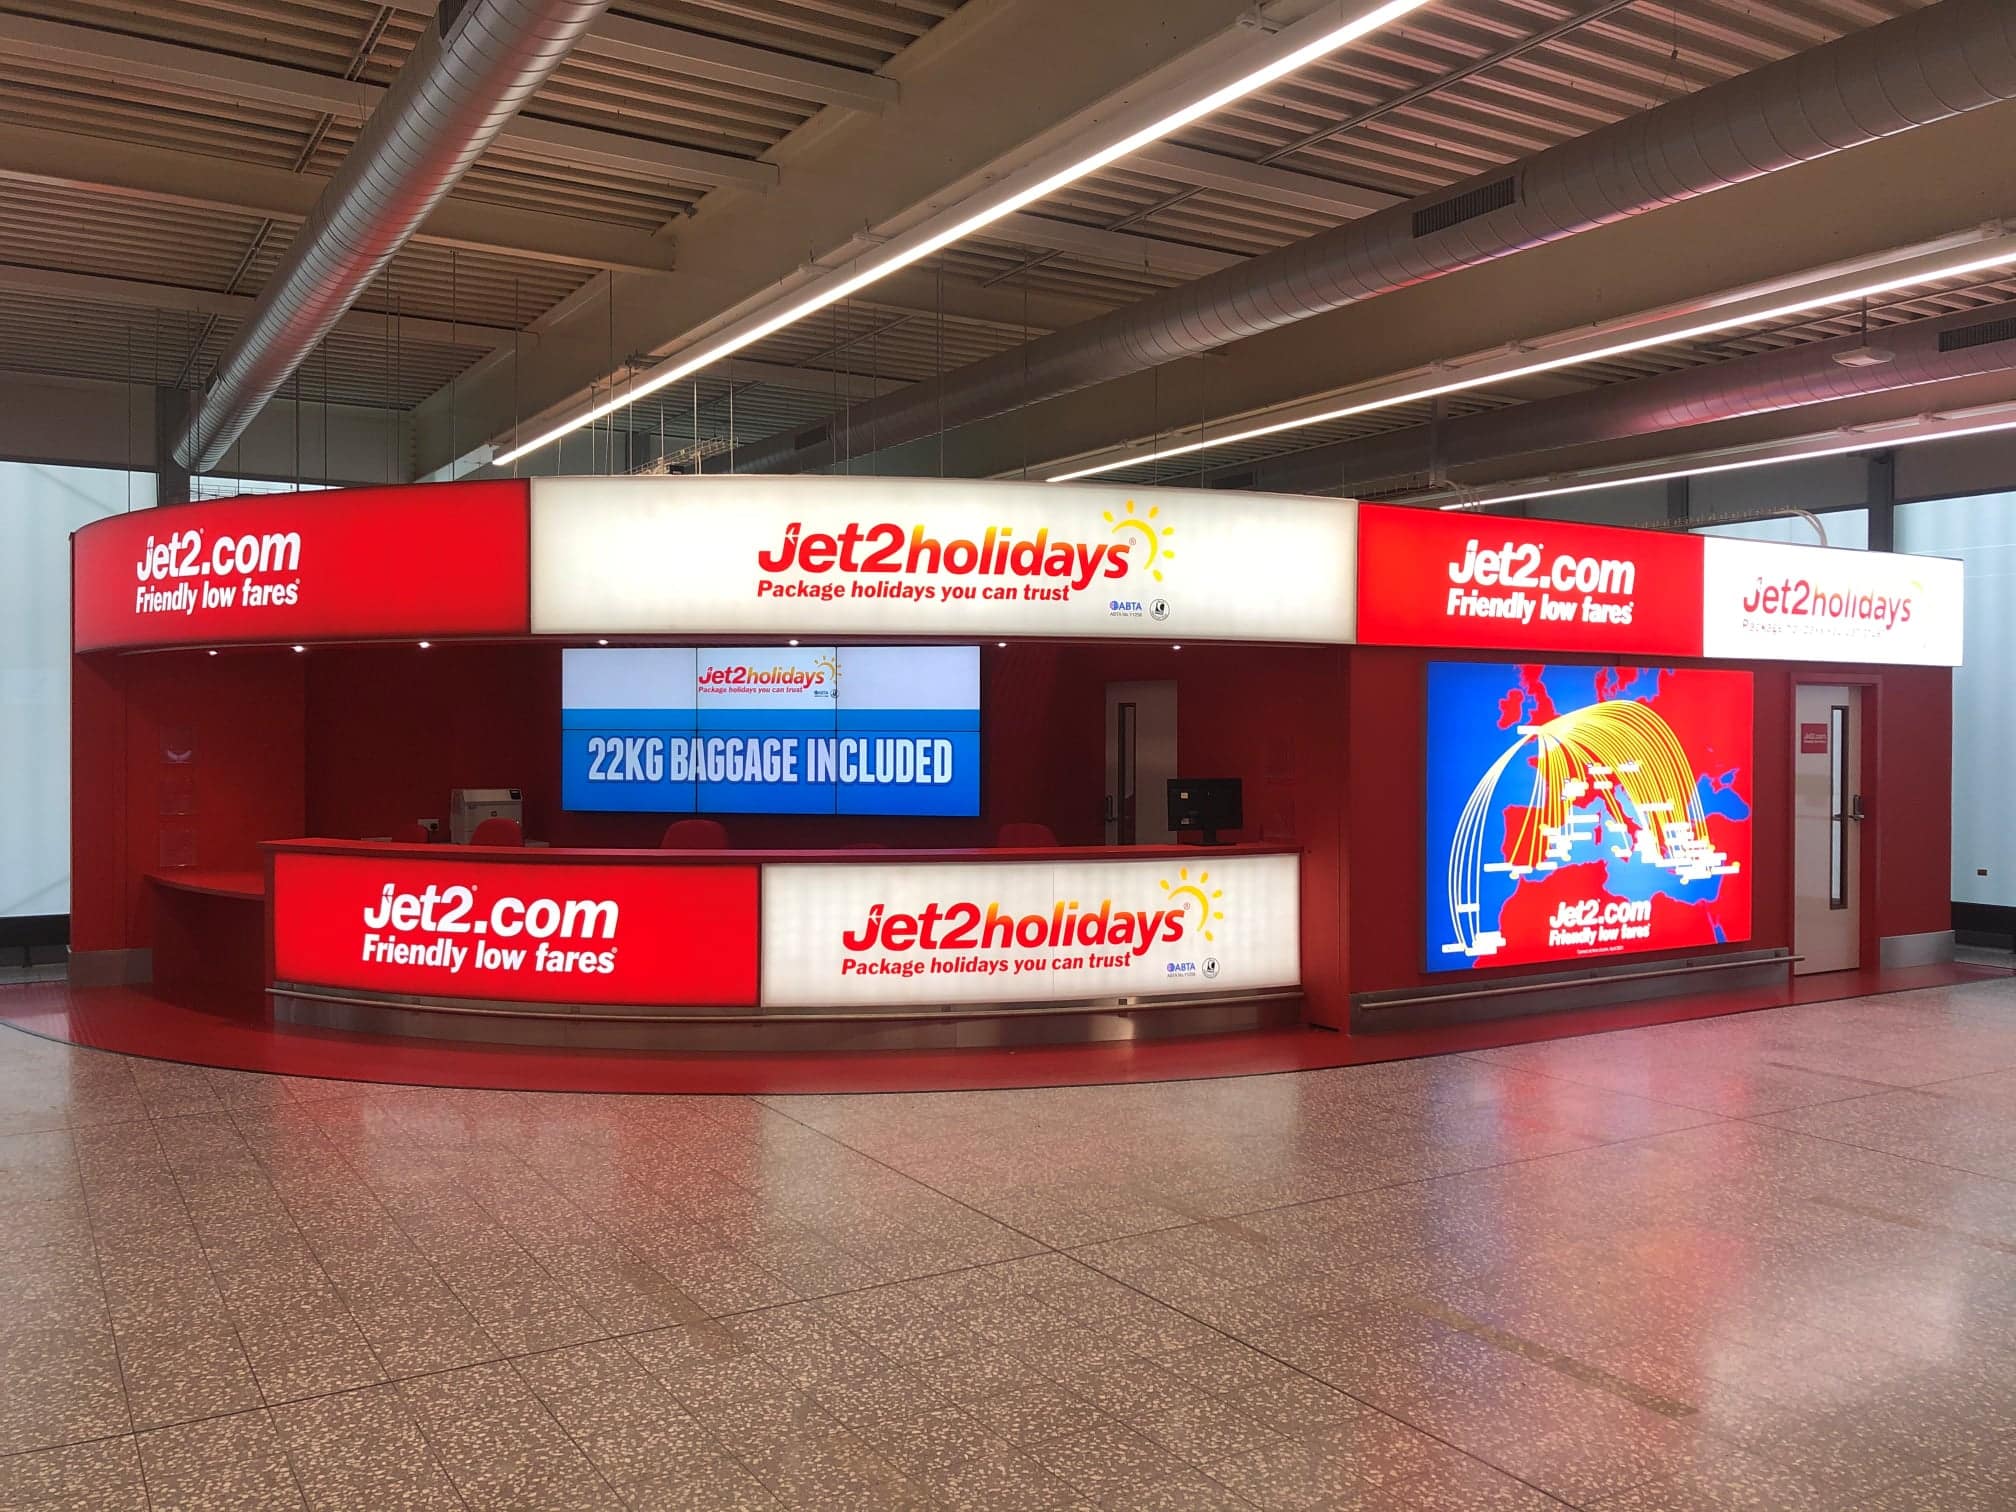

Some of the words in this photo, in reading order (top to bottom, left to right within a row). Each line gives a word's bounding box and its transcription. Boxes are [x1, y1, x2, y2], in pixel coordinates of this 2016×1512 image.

[137, 530, 301, 581] Jet2.com
[758, 522, 1130, 591] Jet2holidays
[1449, 539, 1635, 594] Jet2.com
[136, 582, 198, 615] Friendly
[202, 580, 236, 609] low
[242, 578, 299, 607] fares
[757, 580, 845, 601] Package
[850, 580, 935, 602] holidays
[941, 585, 977, 602] you
[982, 585, 1018, 600] can
[1023, 584, 1070, 601] trust
[1119, 601, 1142, 611] ABTA
[1447, 588, 1536, 624] Friendly
[1540, 593, 1578, 621] low
[1582, 596, 1633, 625] fares
[698, 686, 727, 695] Package
[728, 686, 757, 694] holidays
[758, 687, 771, 695] you
[699, 666, 825, 689] Jet2holidays
[588, 737, 663, 781] 22KG
[670, 737, 798, 782] BAGGAGE
[807, 738, 952, 784] INCLUDED
[363, 883, 619, 939] Jet2.com
[842, 899, 1185, 957] Jet2holidays
[1549, 899, 1652, 928] Jet2.com
[362, 933, 468, 974] Friendly
[475, 939, 528, 970] low
[535, 942, 616, 974] fares
[841, 958, 924, 978] Package
[930, 956, 1009, 975] holidays
[1013, 957, 1047, 974] you
[1052, 956, 1083, 971] can
[1088, 952, 1132, 969] trust
